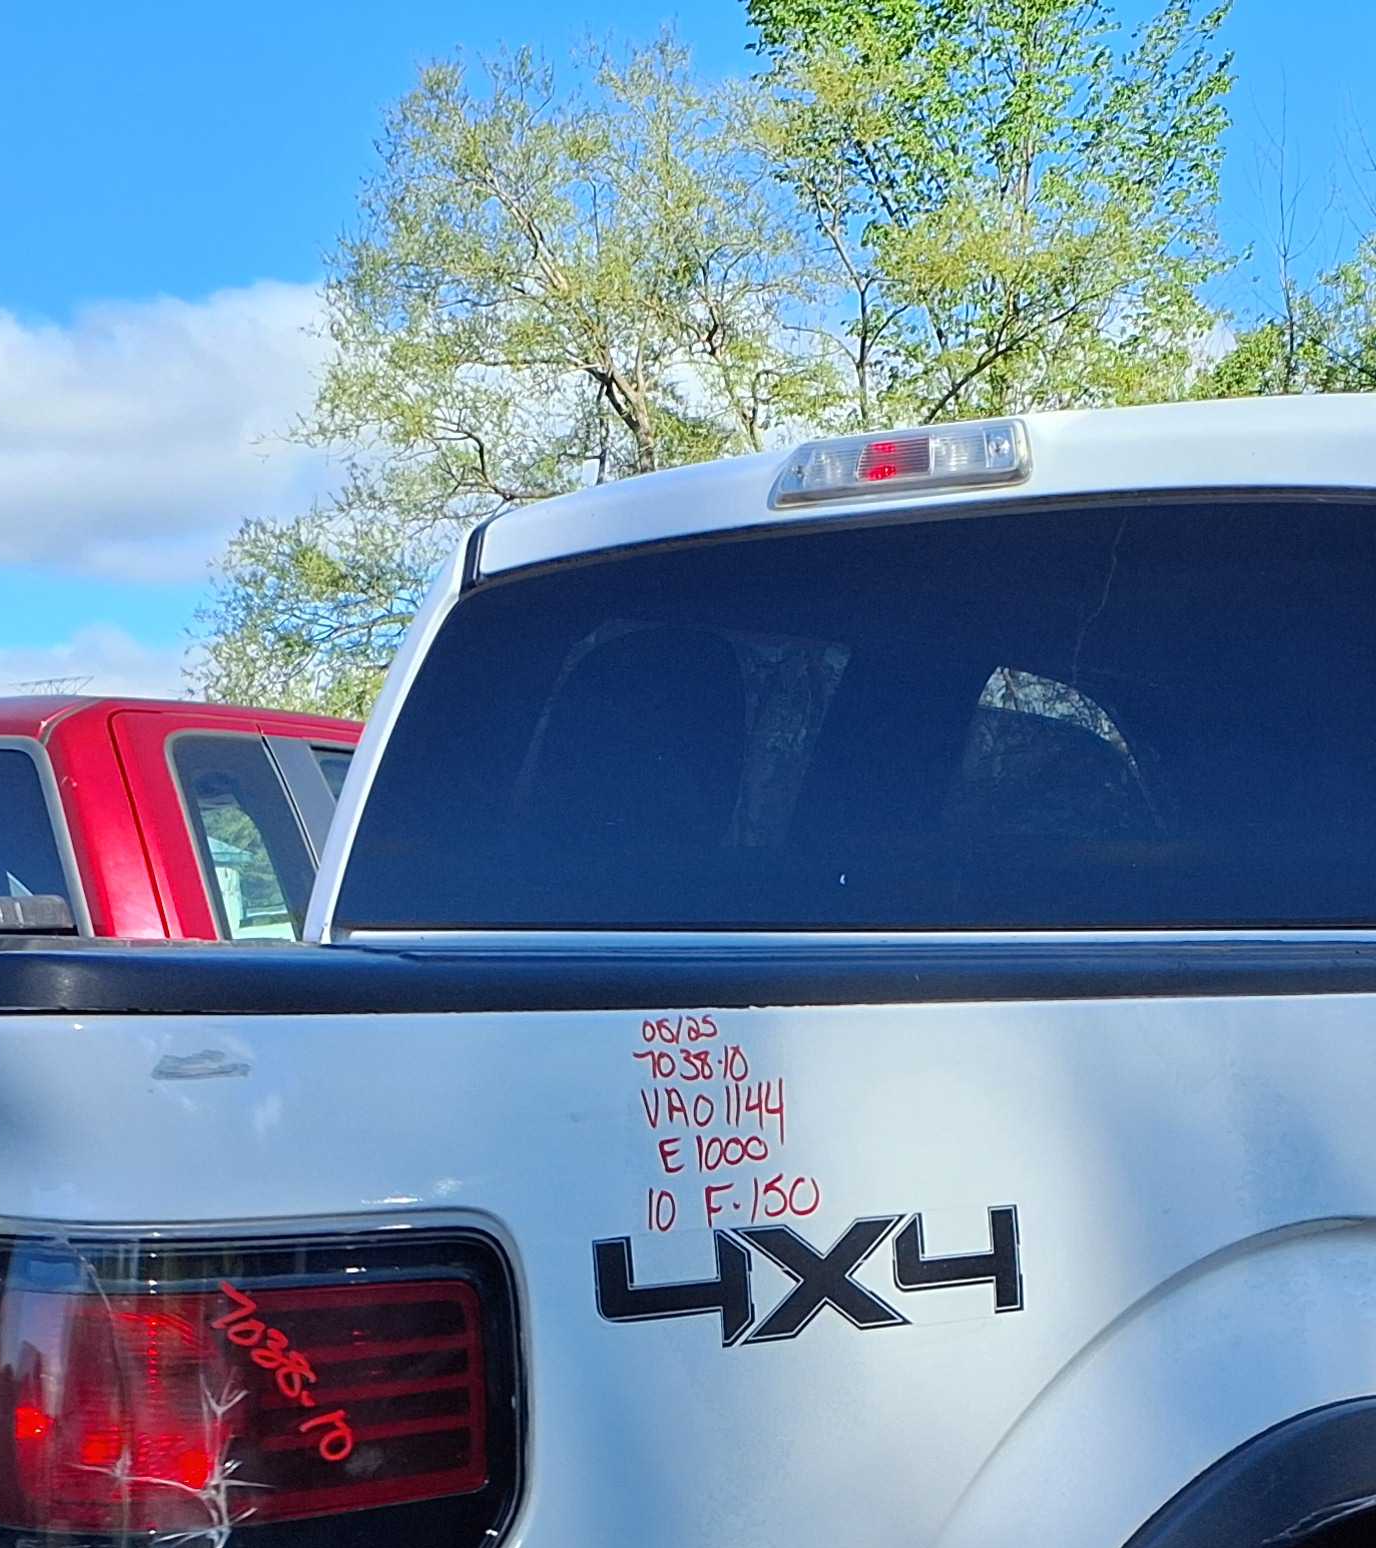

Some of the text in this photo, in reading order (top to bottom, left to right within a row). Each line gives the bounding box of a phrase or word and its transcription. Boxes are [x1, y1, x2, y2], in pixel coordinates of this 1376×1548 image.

[658, 1134, 769, 1174] E 1000
[648, 1186, 677, 1232] 10
[591, 1203, 1024, 1349] 4X4
